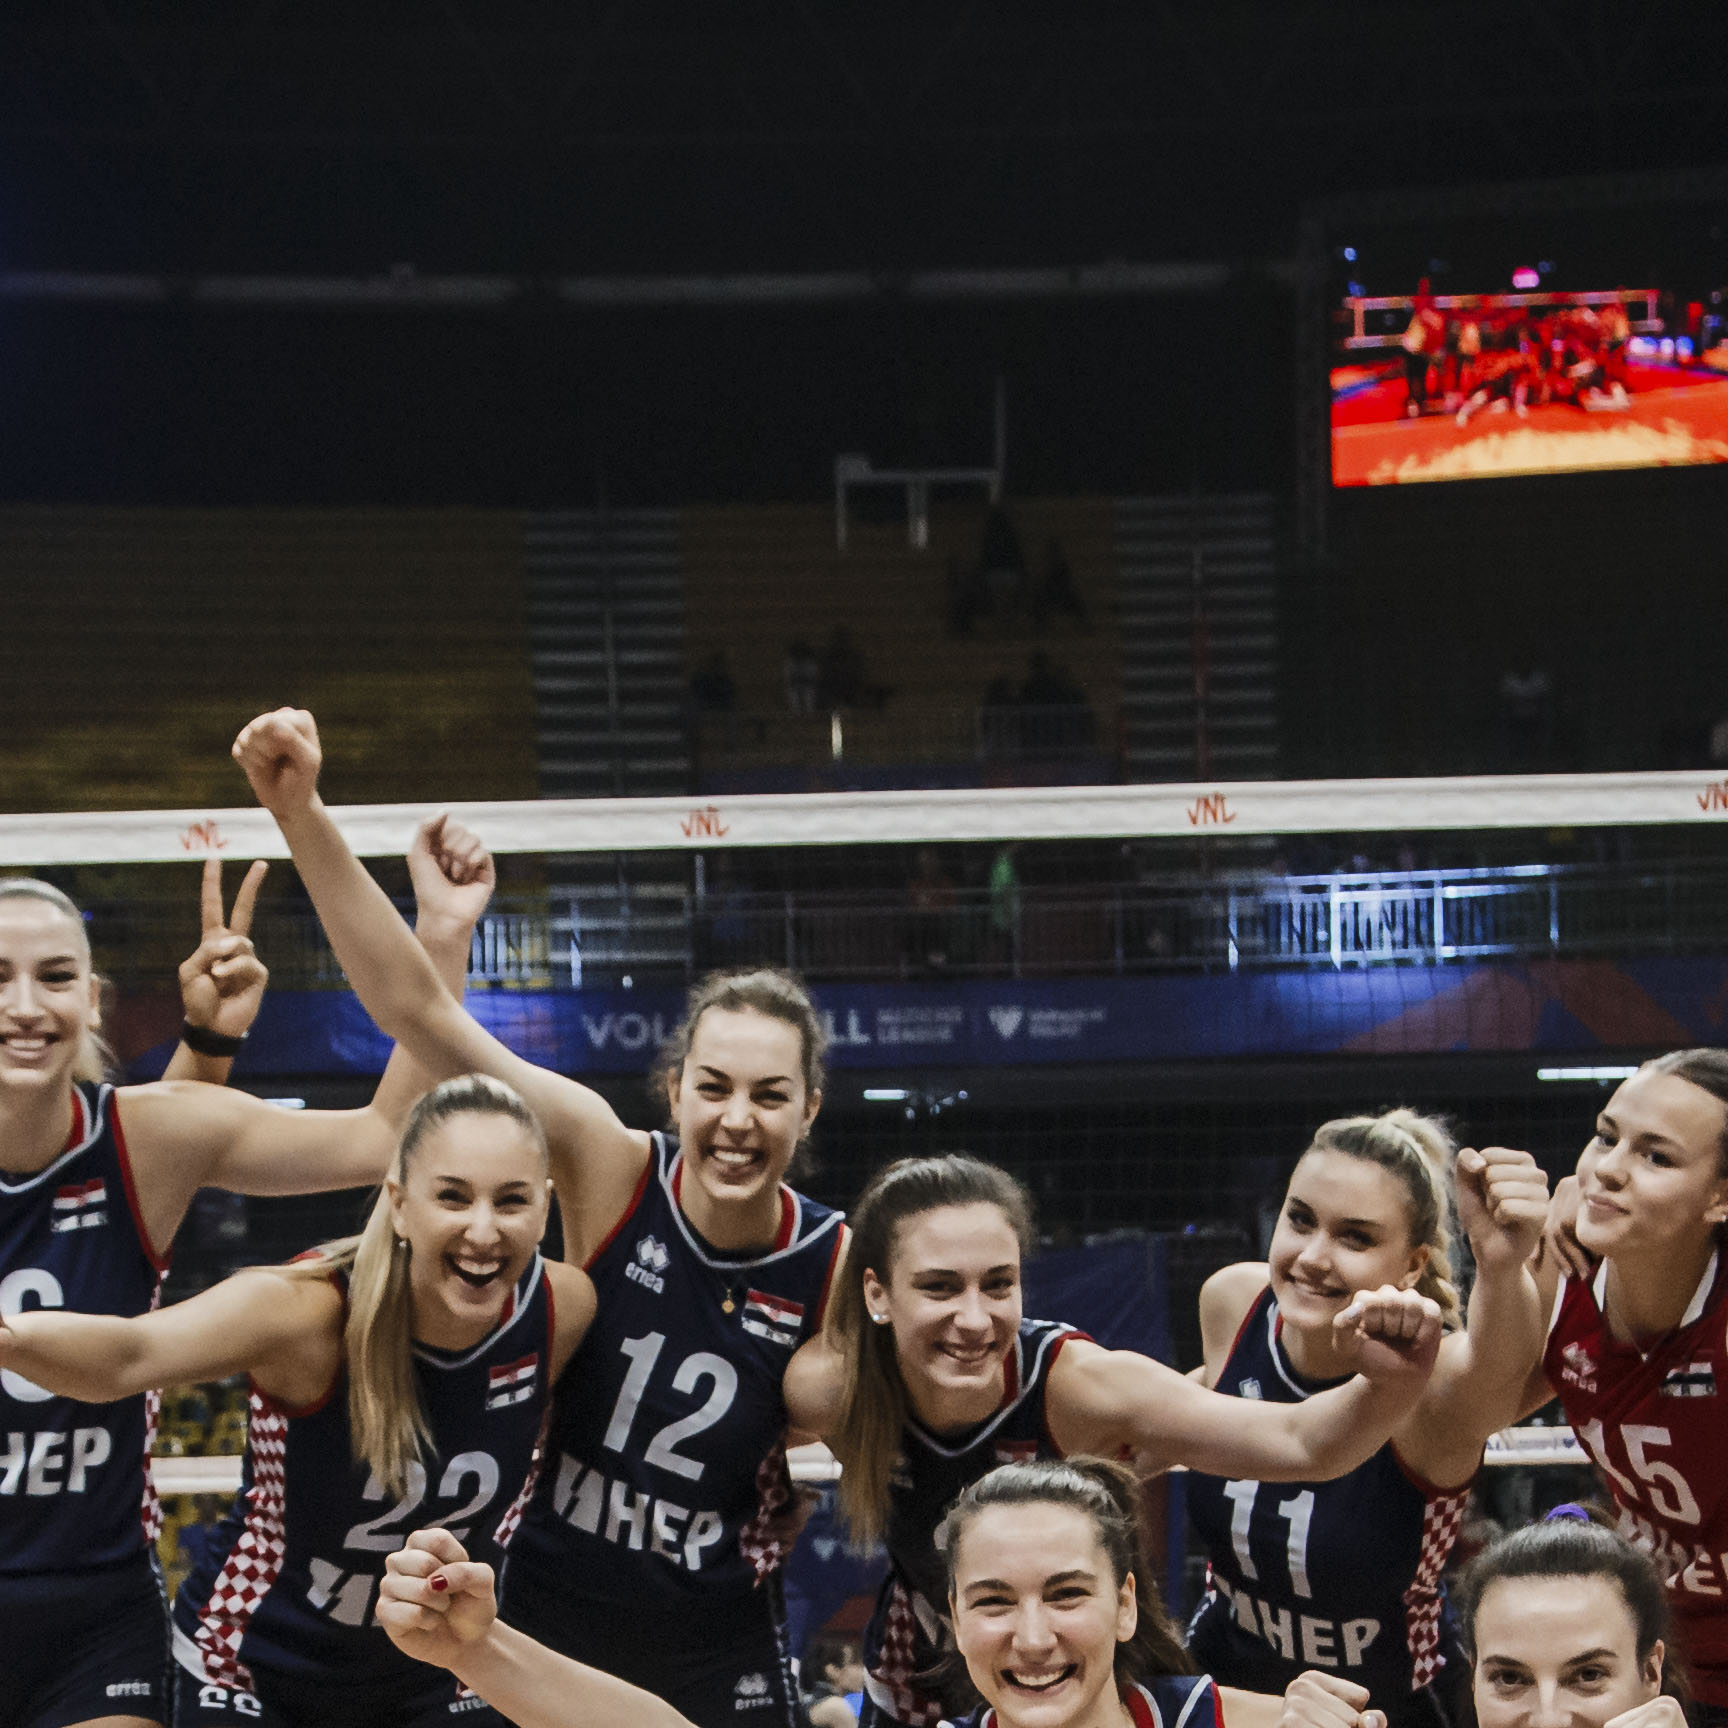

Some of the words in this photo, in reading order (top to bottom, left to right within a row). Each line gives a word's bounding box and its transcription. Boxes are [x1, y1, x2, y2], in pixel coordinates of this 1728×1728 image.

[678, 804, 730, 837] VNL
[1187, 791, 1238, 826] VNL
[602, 1331, 738, 1482] 12
[343, 1451, 500, 1552] 22
[1576, 1418, 1701, 1526] 15
[1219, 1480, 1315, 1599] 11
